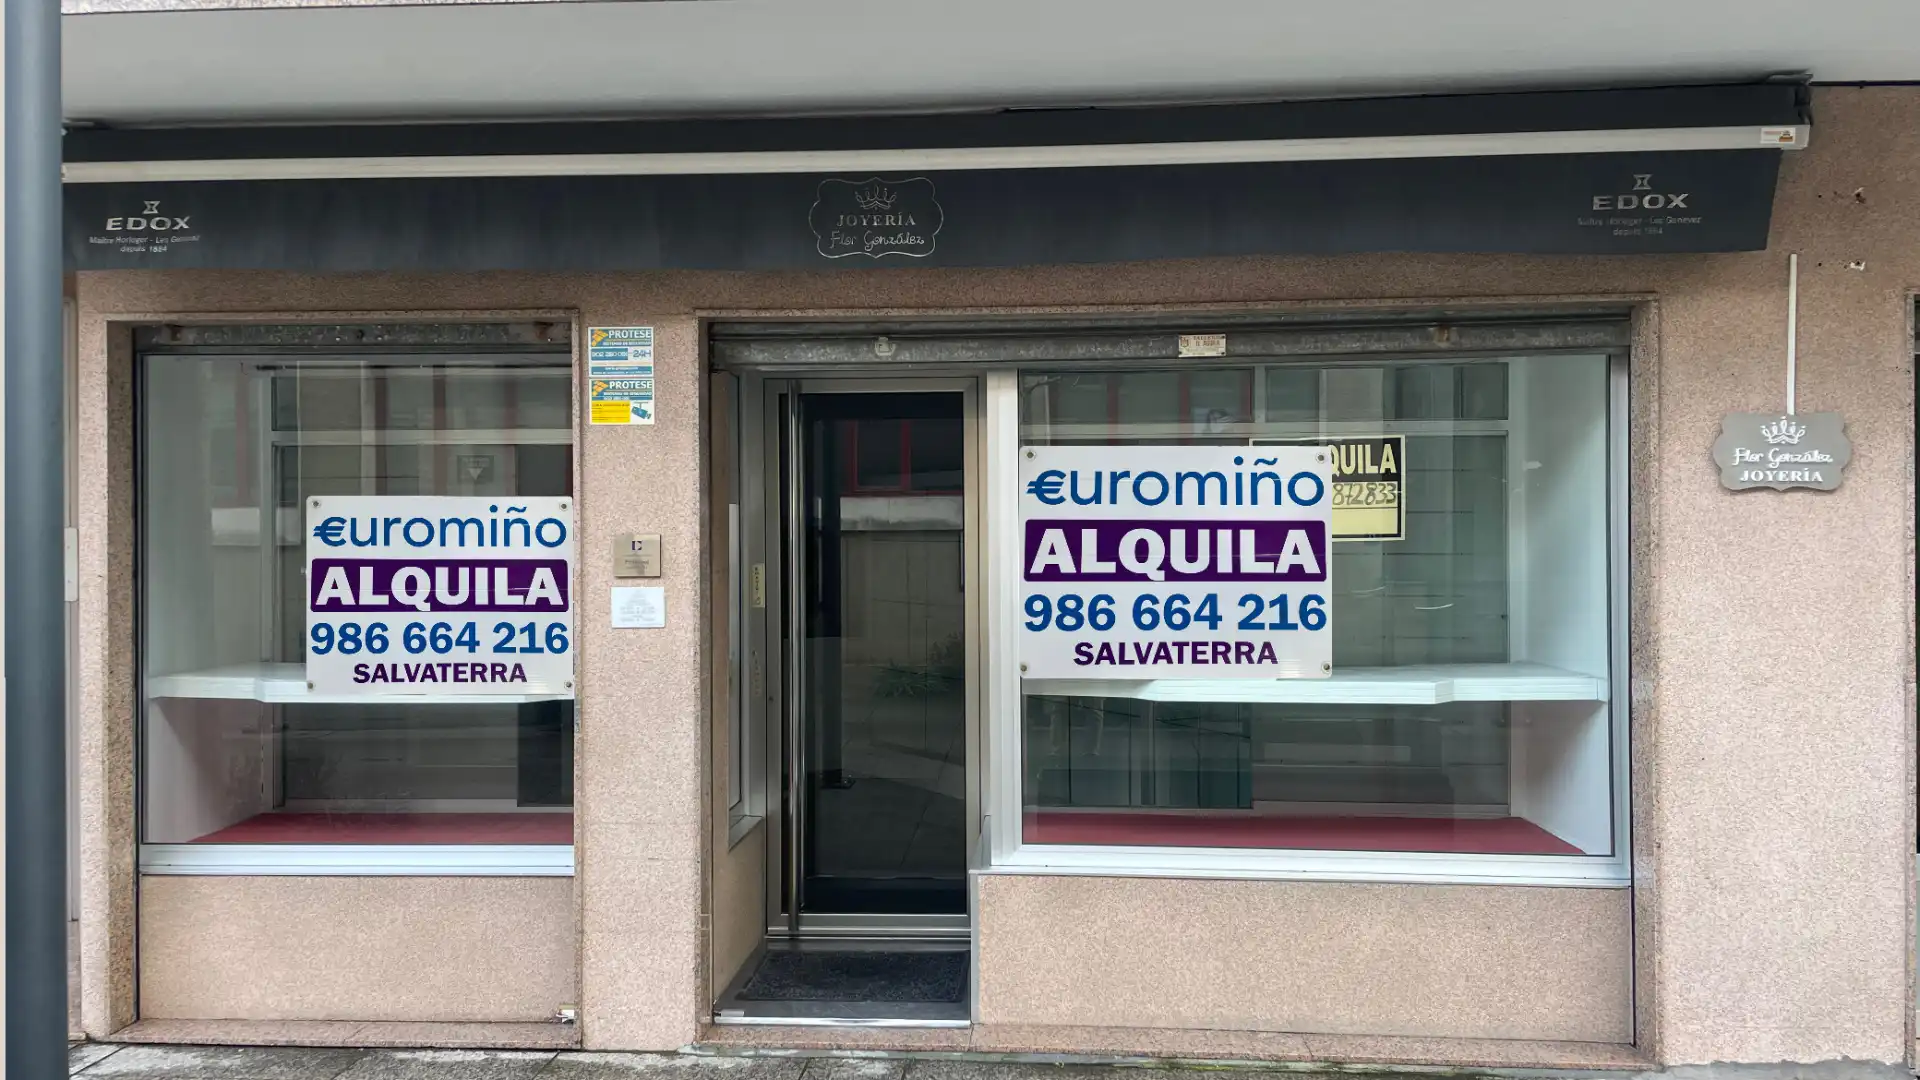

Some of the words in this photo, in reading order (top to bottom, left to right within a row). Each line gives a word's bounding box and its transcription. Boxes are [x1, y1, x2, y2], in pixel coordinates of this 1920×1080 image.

[1592, 193, 1689, 211] EDOX
[106, 216, 190, 230] EDOX
[837, 211, 916, 226] JOYERÍA
[829, 229, 857, 249] Flor
[863, 230, 925, 251] González
[608, 330, 652, 339] PROTESE
[609, 380, 653, 389] PROTESE
[1329, 443, 1397, 477] QUILA
[1732, 448, 1764, 466] Flor
[1767, 447, 1834, 469] González
[1740, 467, 1824, 482] JOYERÍA
[1029, 528, 1322, 582] ALQUILA
[315, 566, 565, 612] ALQUILA
[1024, 593, 1116, 632] 986
[1132, 593, 1223, 632] 664
[1237, 593, 1327, 631] 216
[310, 621, 390, 655] 986
[402, 621, 480, 654] 664
[492, 621, 569, 654] 216
[1073, 640, 1279, 666] SALVATERRA
[353, 662, 528, 684] SALVATERRA
